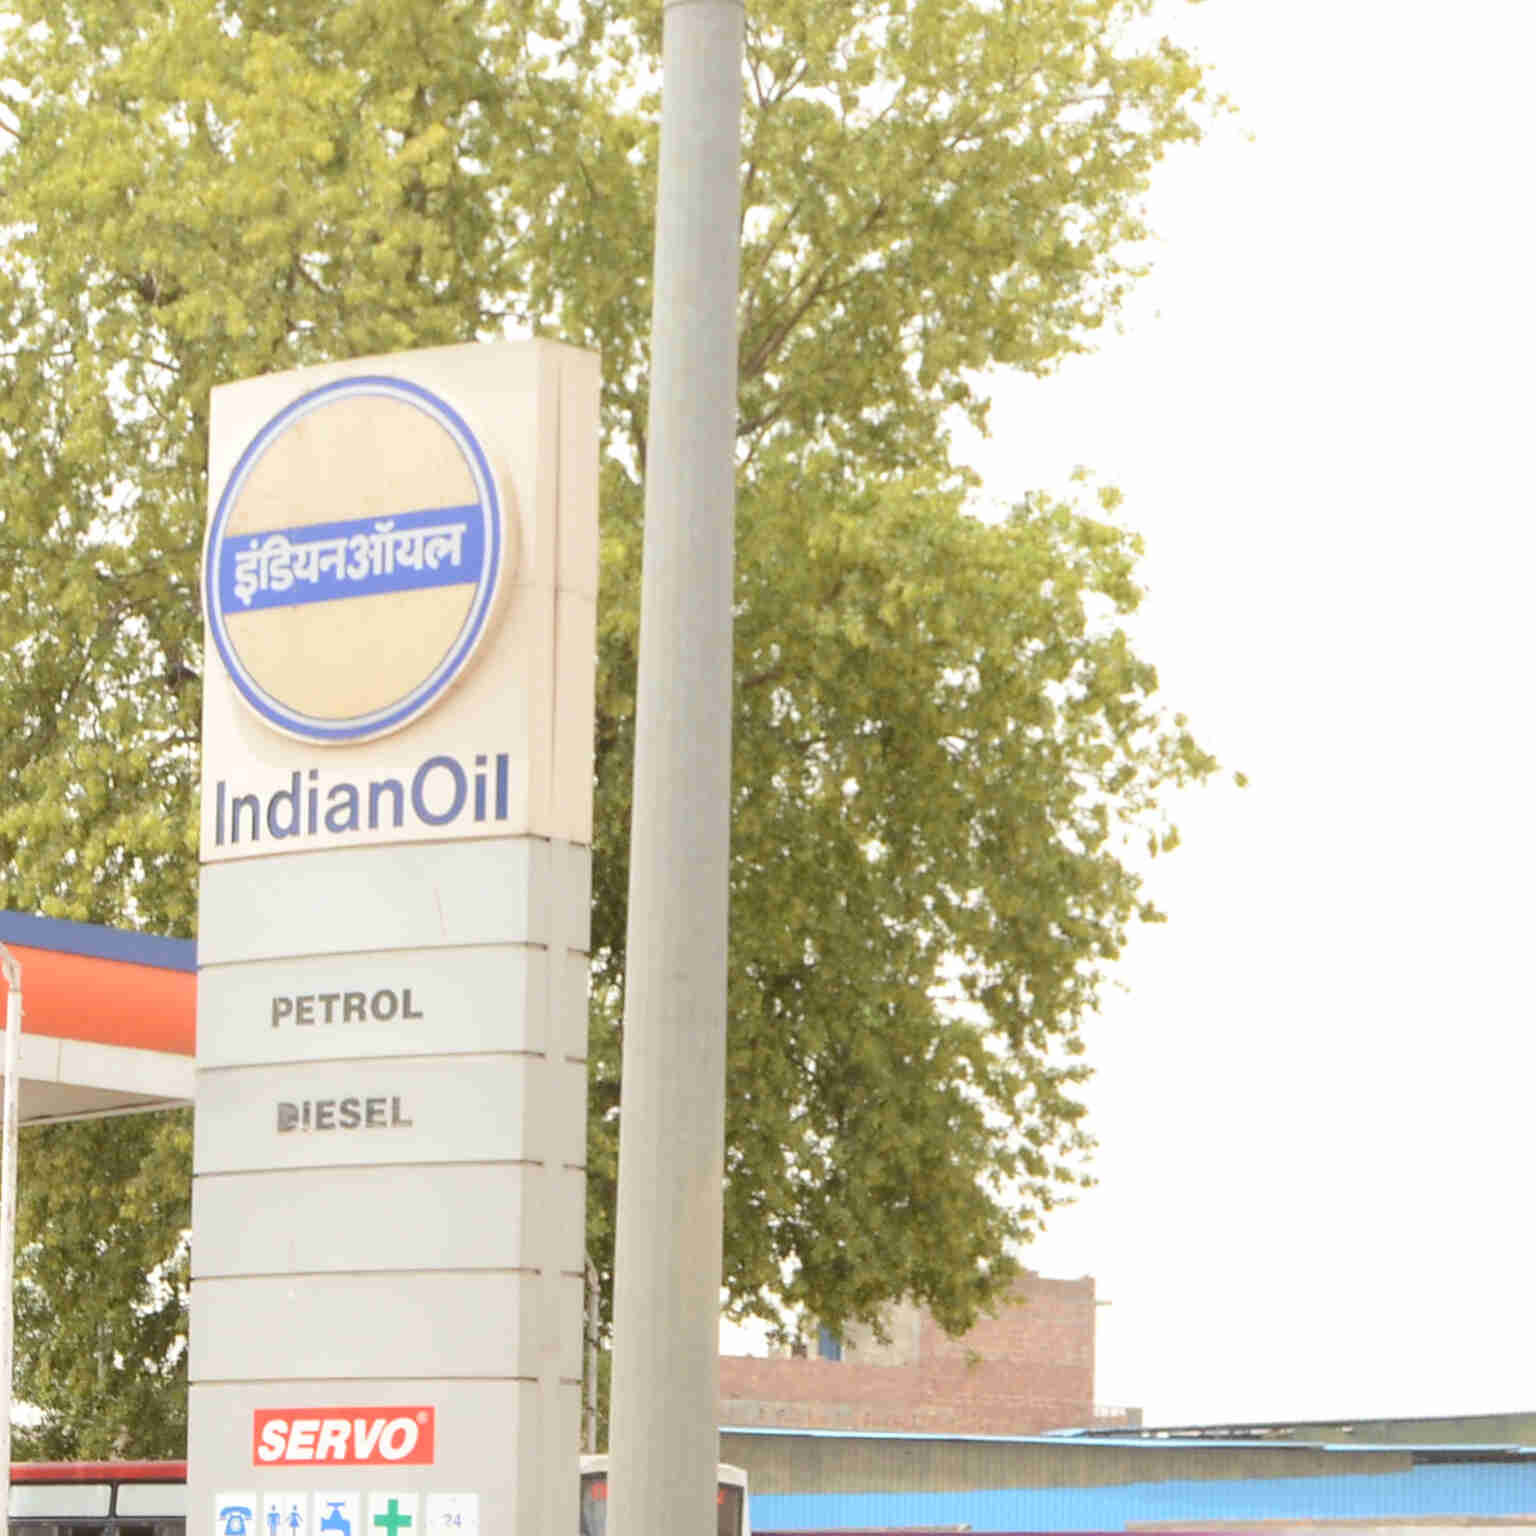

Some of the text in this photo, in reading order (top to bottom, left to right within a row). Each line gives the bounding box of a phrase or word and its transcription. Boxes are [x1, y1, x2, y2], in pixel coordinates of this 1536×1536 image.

[271, 988, 425, 1028] PETROL
[276, 1096, 414, 1132] DIESEL
[257, 1417, 419, 1461] SERVO
